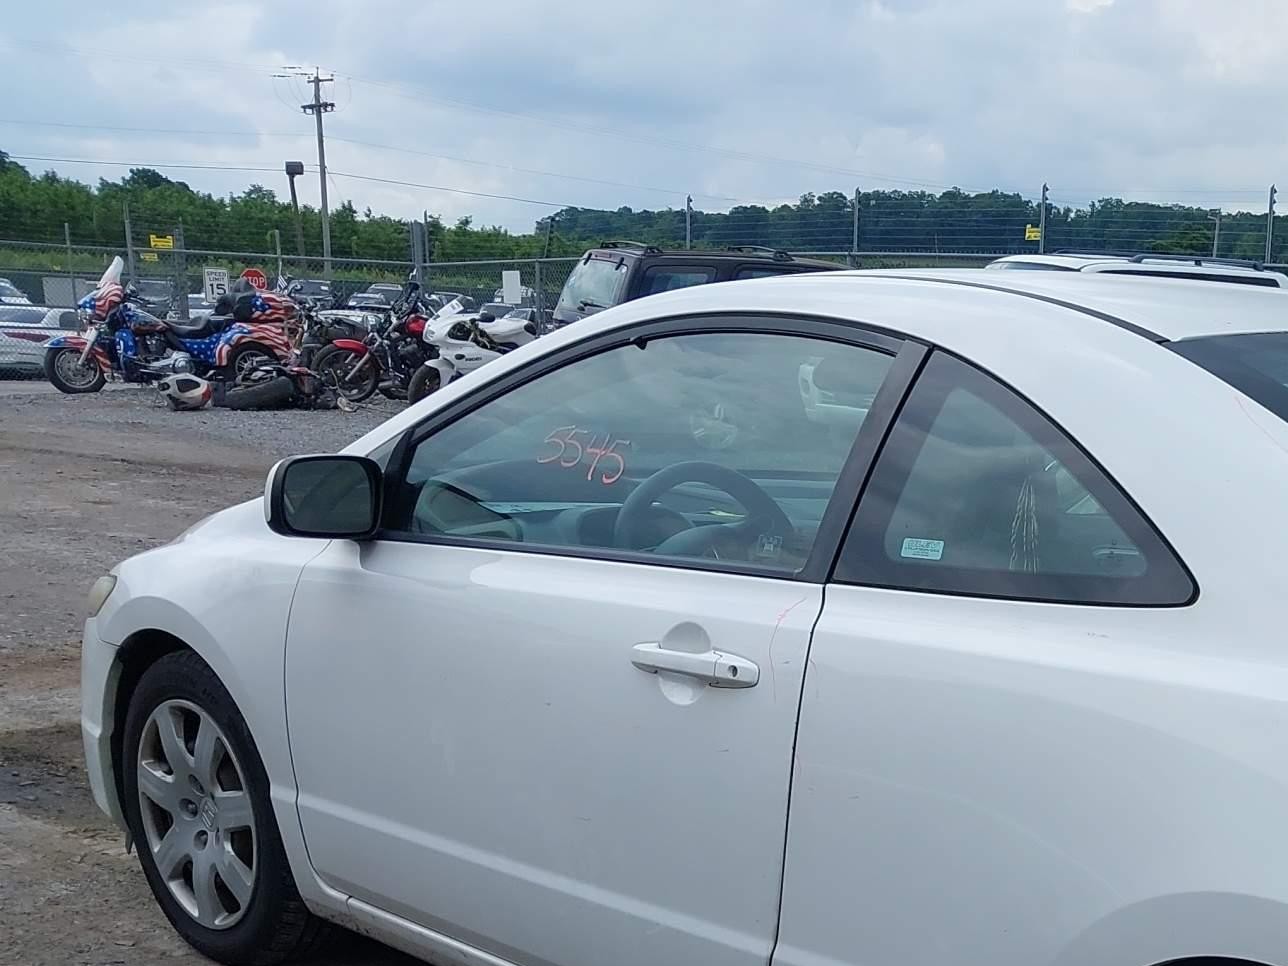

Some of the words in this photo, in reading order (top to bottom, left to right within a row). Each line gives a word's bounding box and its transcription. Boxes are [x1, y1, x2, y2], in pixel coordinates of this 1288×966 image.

[247, 276, 265, 287] TOP
[209, 283, 226, 295] 15
[537, 425, 631, 483] 5545
